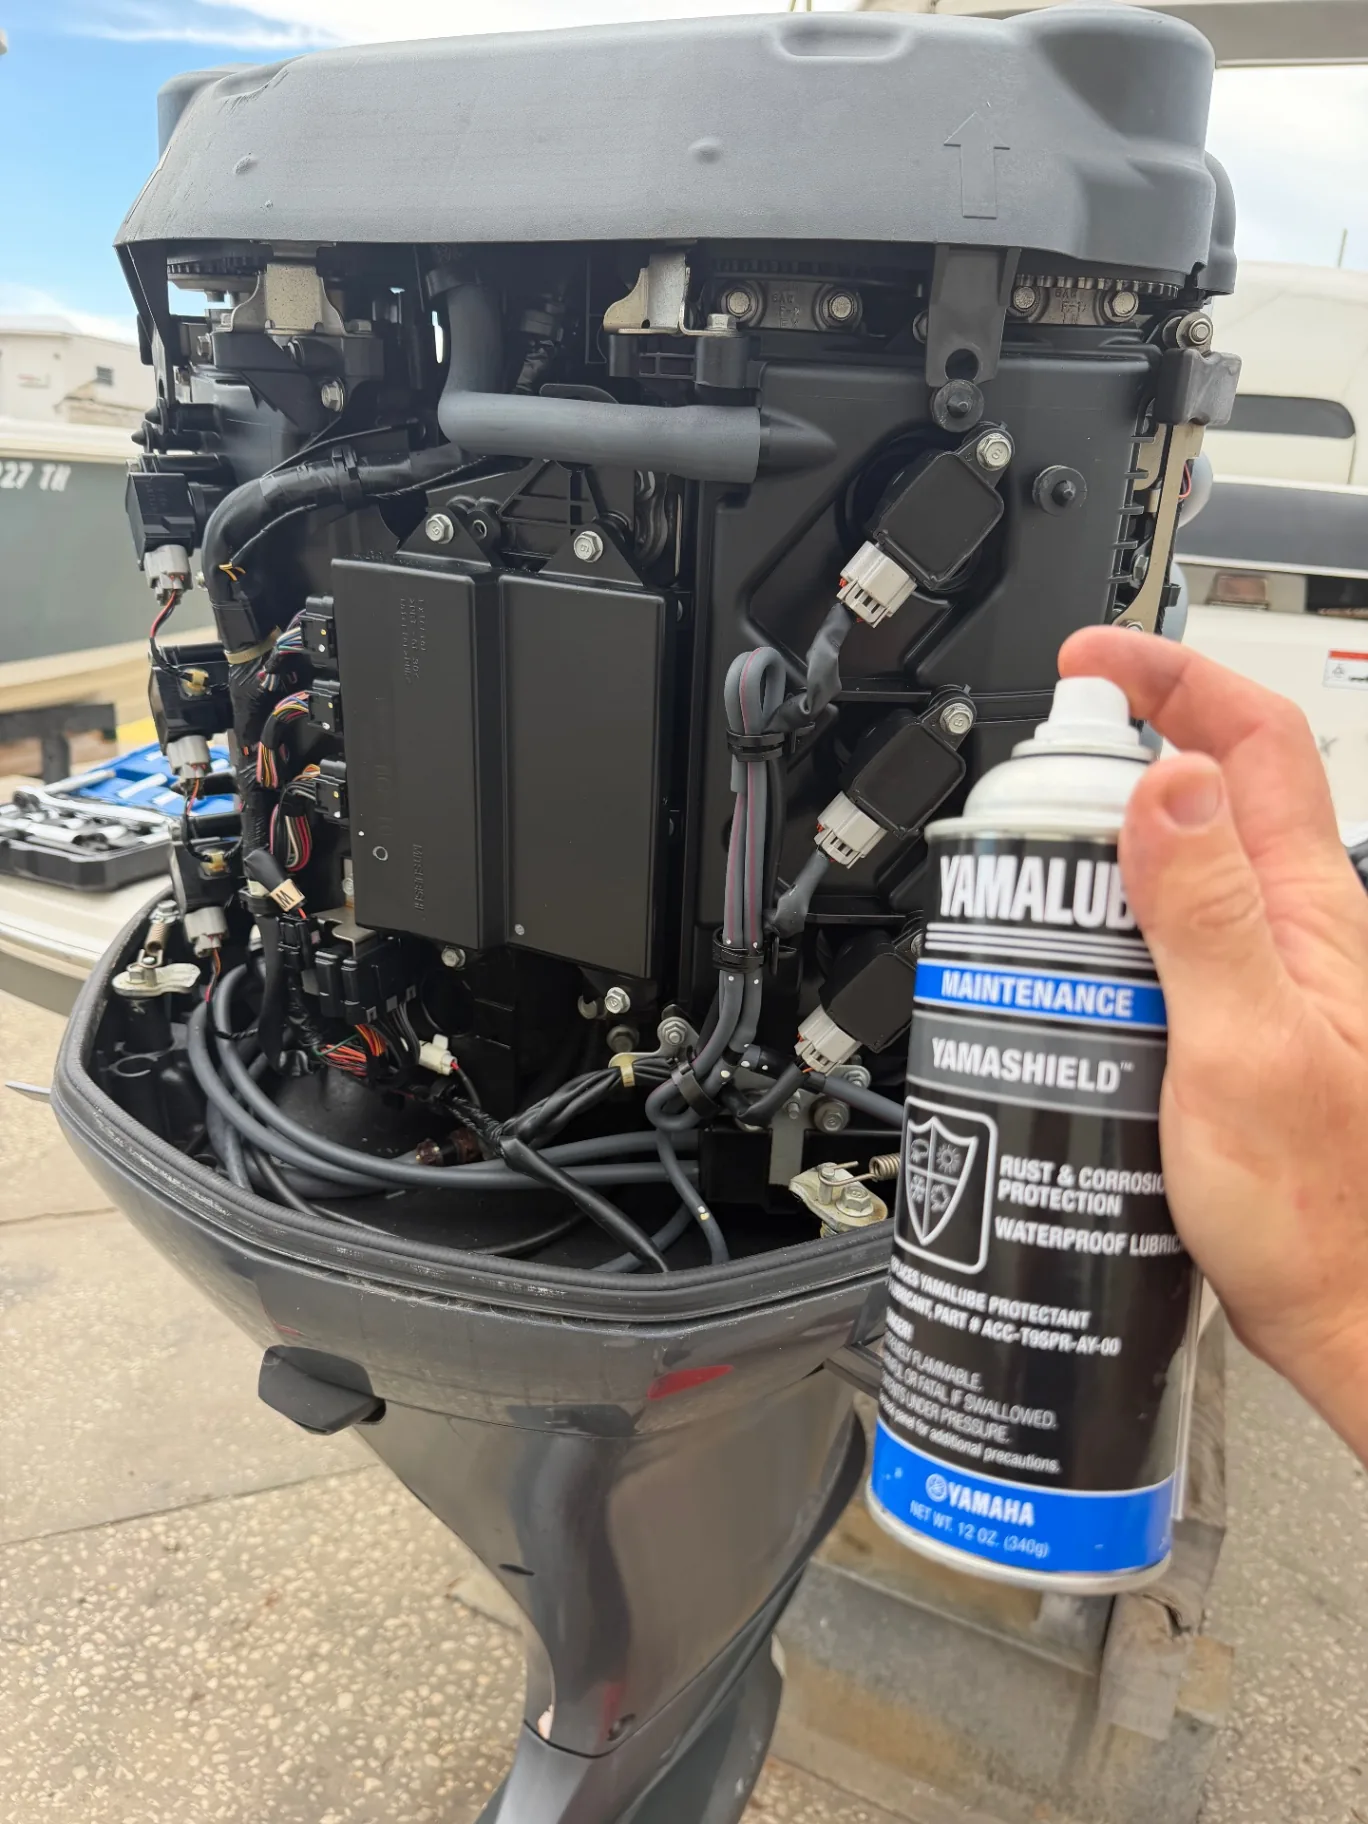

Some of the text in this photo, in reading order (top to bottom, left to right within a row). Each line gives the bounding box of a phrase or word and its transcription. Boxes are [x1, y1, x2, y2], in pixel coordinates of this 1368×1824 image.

[940, 854, 1138, 930] YAMALUB
[941, 970, 1134, 1018] MAINTENANCE
[997, 1178, 1123, 1217] PROTECTION
[1000, 1154, 1164, 1195] RUST & CORROSIO
[994, 1216, 1182, 1257] WATERPROOF LUBRIC
[920, 1273, 988, 1313] YAMALUBE
[988, 1295, 1092, 1331] PROTECTANT
[934, 1303, 969, 1331] PART
[968, 1315, 982, 1335] #
[904, 1367, 918, 1388] OR
[917, 1374, 950, 1404] FATAL
[950, 1388, 964, 1407] IF
[963, 1393, 1059, 1431] SWALLOWED.
[905, 1391, 941, 1422] UNDER
[940, 1407, 1012, 1444] PRESSURE.
[915, 1418, 931, 1438] for
[929, 1427, 984, 1458] additional
[983, 1447, 1063, 1475] precautions.
[909, 1499, 1051, 1559] NET WT. 12 OZ. (340g)
[948, 1481, 1036, 1528] YAMAHA
